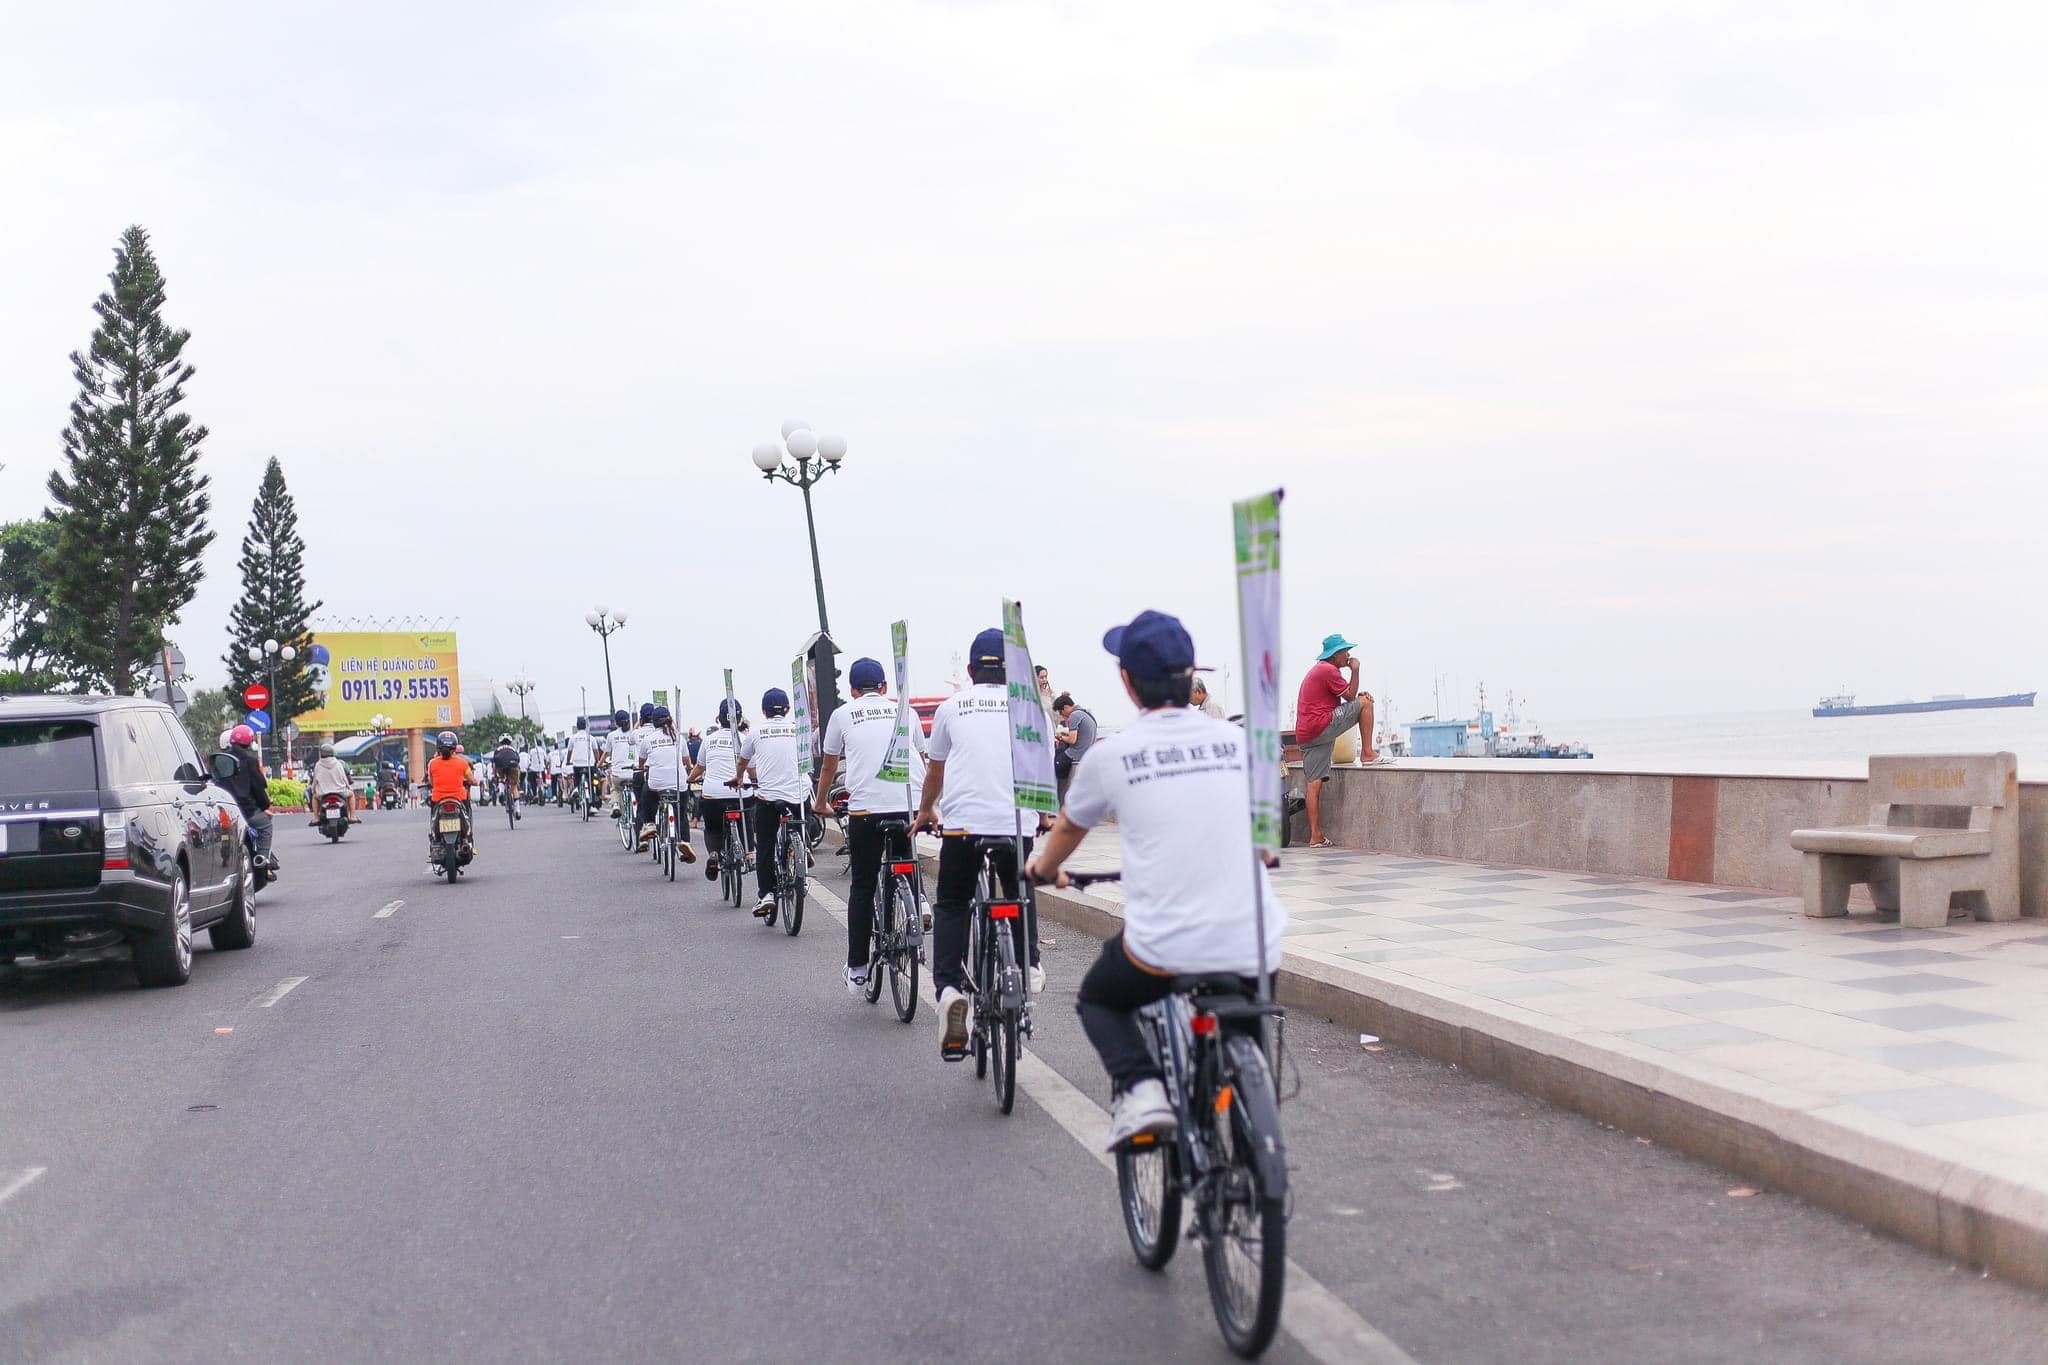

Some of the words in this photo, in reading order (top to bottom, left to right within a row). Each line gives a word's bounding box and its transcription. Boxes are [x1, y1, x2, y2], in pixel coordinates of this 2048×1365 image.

[341, 657, 363, 672] LIÊN
[342, 678, 449, 701] 0911.39.5555
[1933, 767, 1967, 789] BANK
